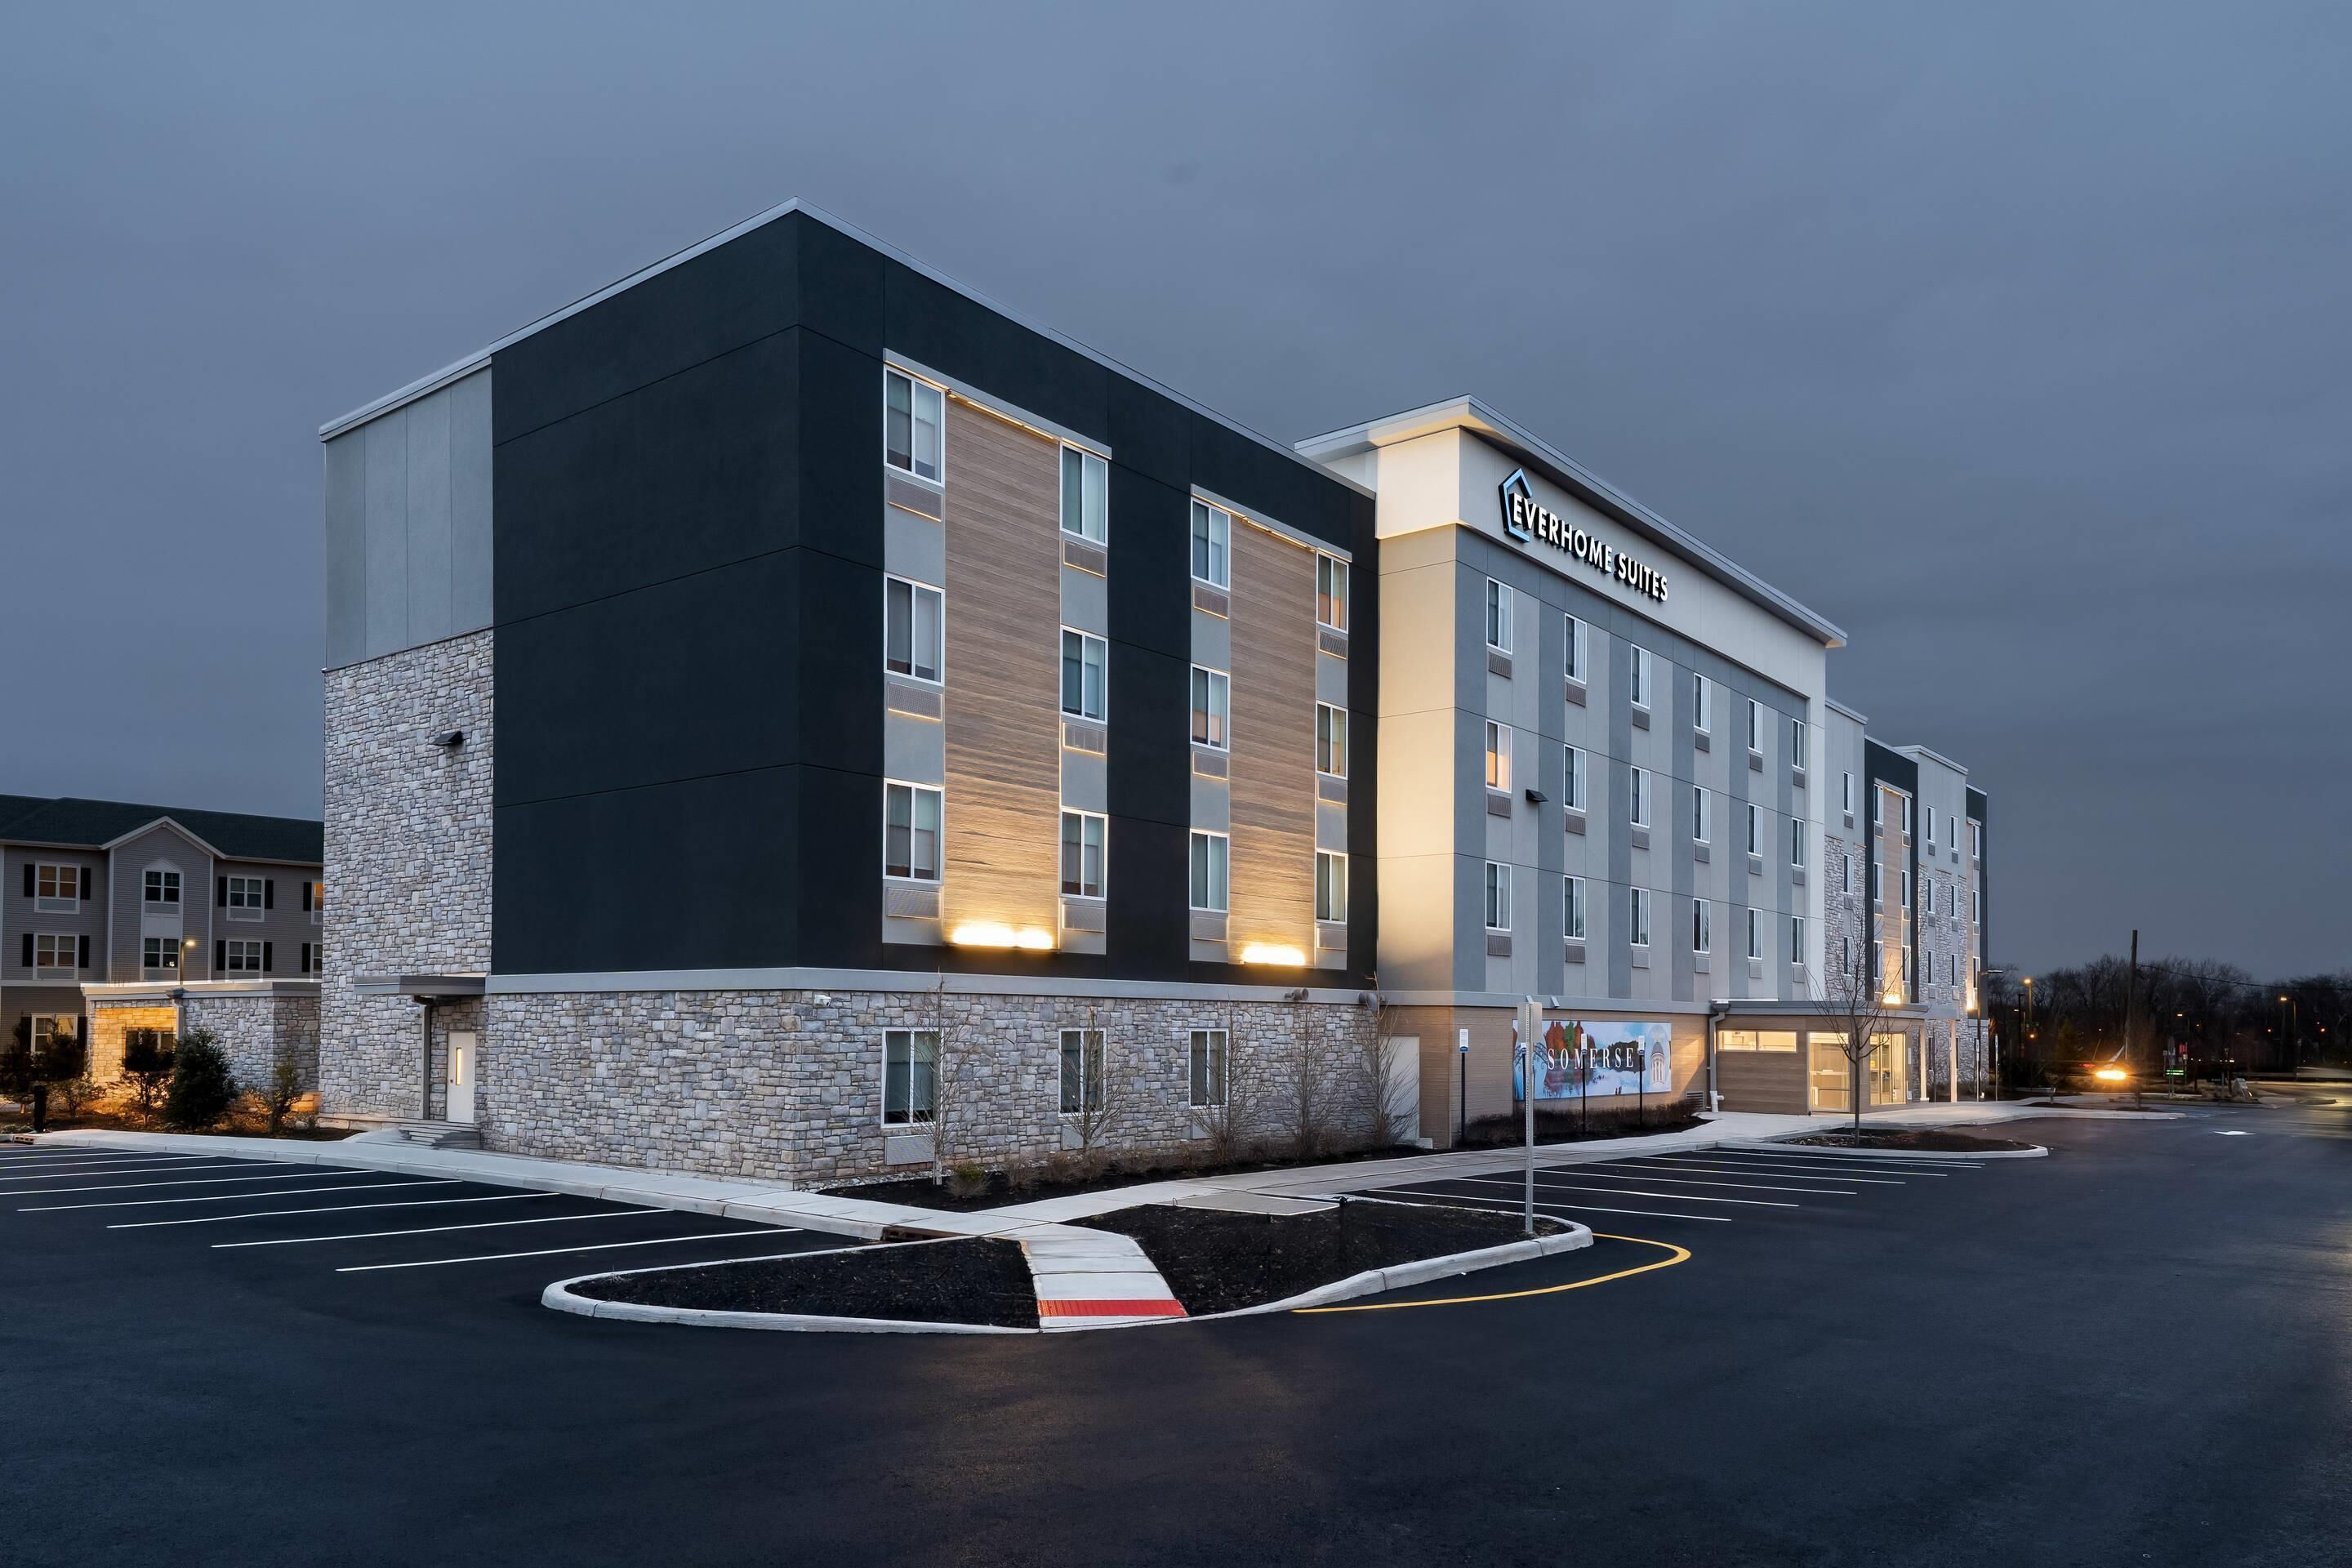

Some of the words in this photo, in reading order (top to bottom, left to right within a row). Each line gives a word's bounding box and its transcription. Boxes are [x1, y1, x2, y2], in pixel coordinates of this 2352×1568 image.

[1512, 492, 1613, 572] EVERHOME
[1618, 552, 1668, 602] SUITES
[1548, 1048, 1642, 1070] SOMERSE
